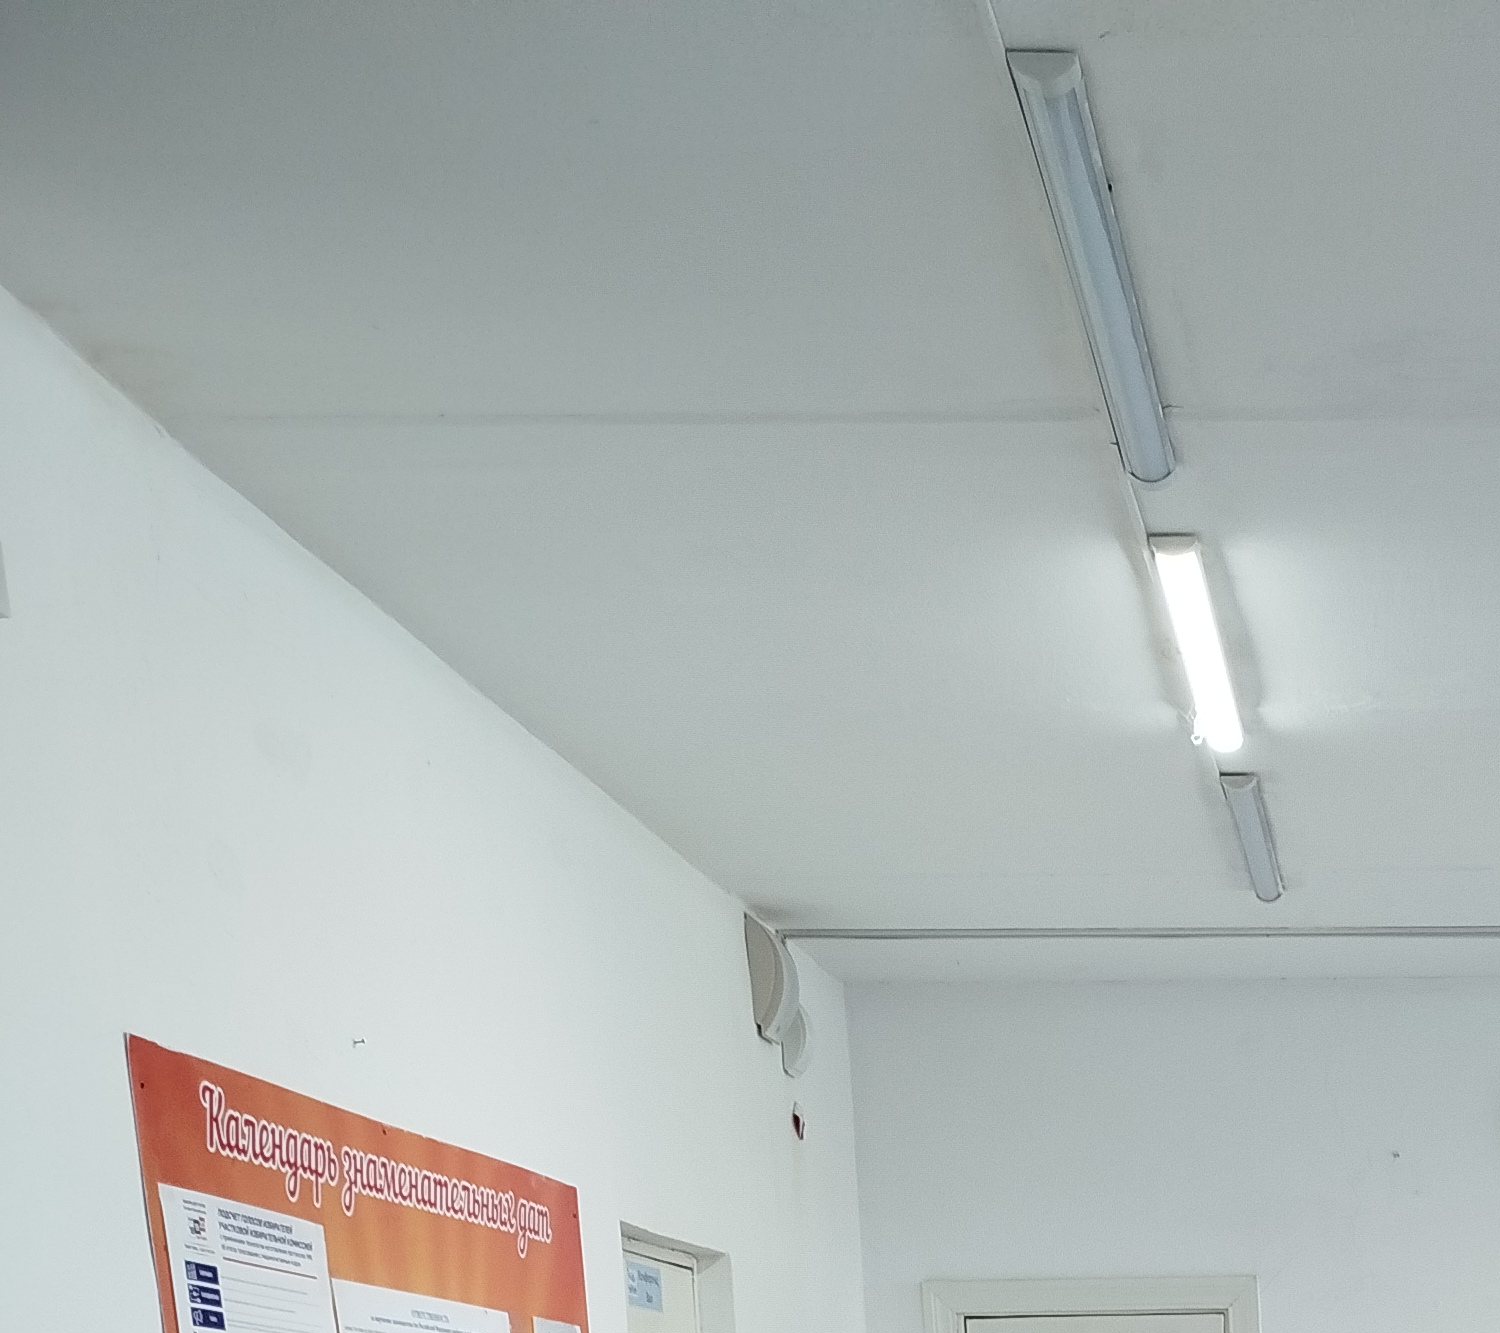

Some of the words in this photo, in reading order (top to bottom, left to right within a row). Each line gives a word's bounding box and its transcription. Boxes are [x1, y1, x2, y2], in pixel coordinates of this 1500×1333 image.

[199, 1080, 339, 1208] Календарь
[341, 1146, 516, 1233] знаменательных
[517, 1198, 553, 1258] дат
